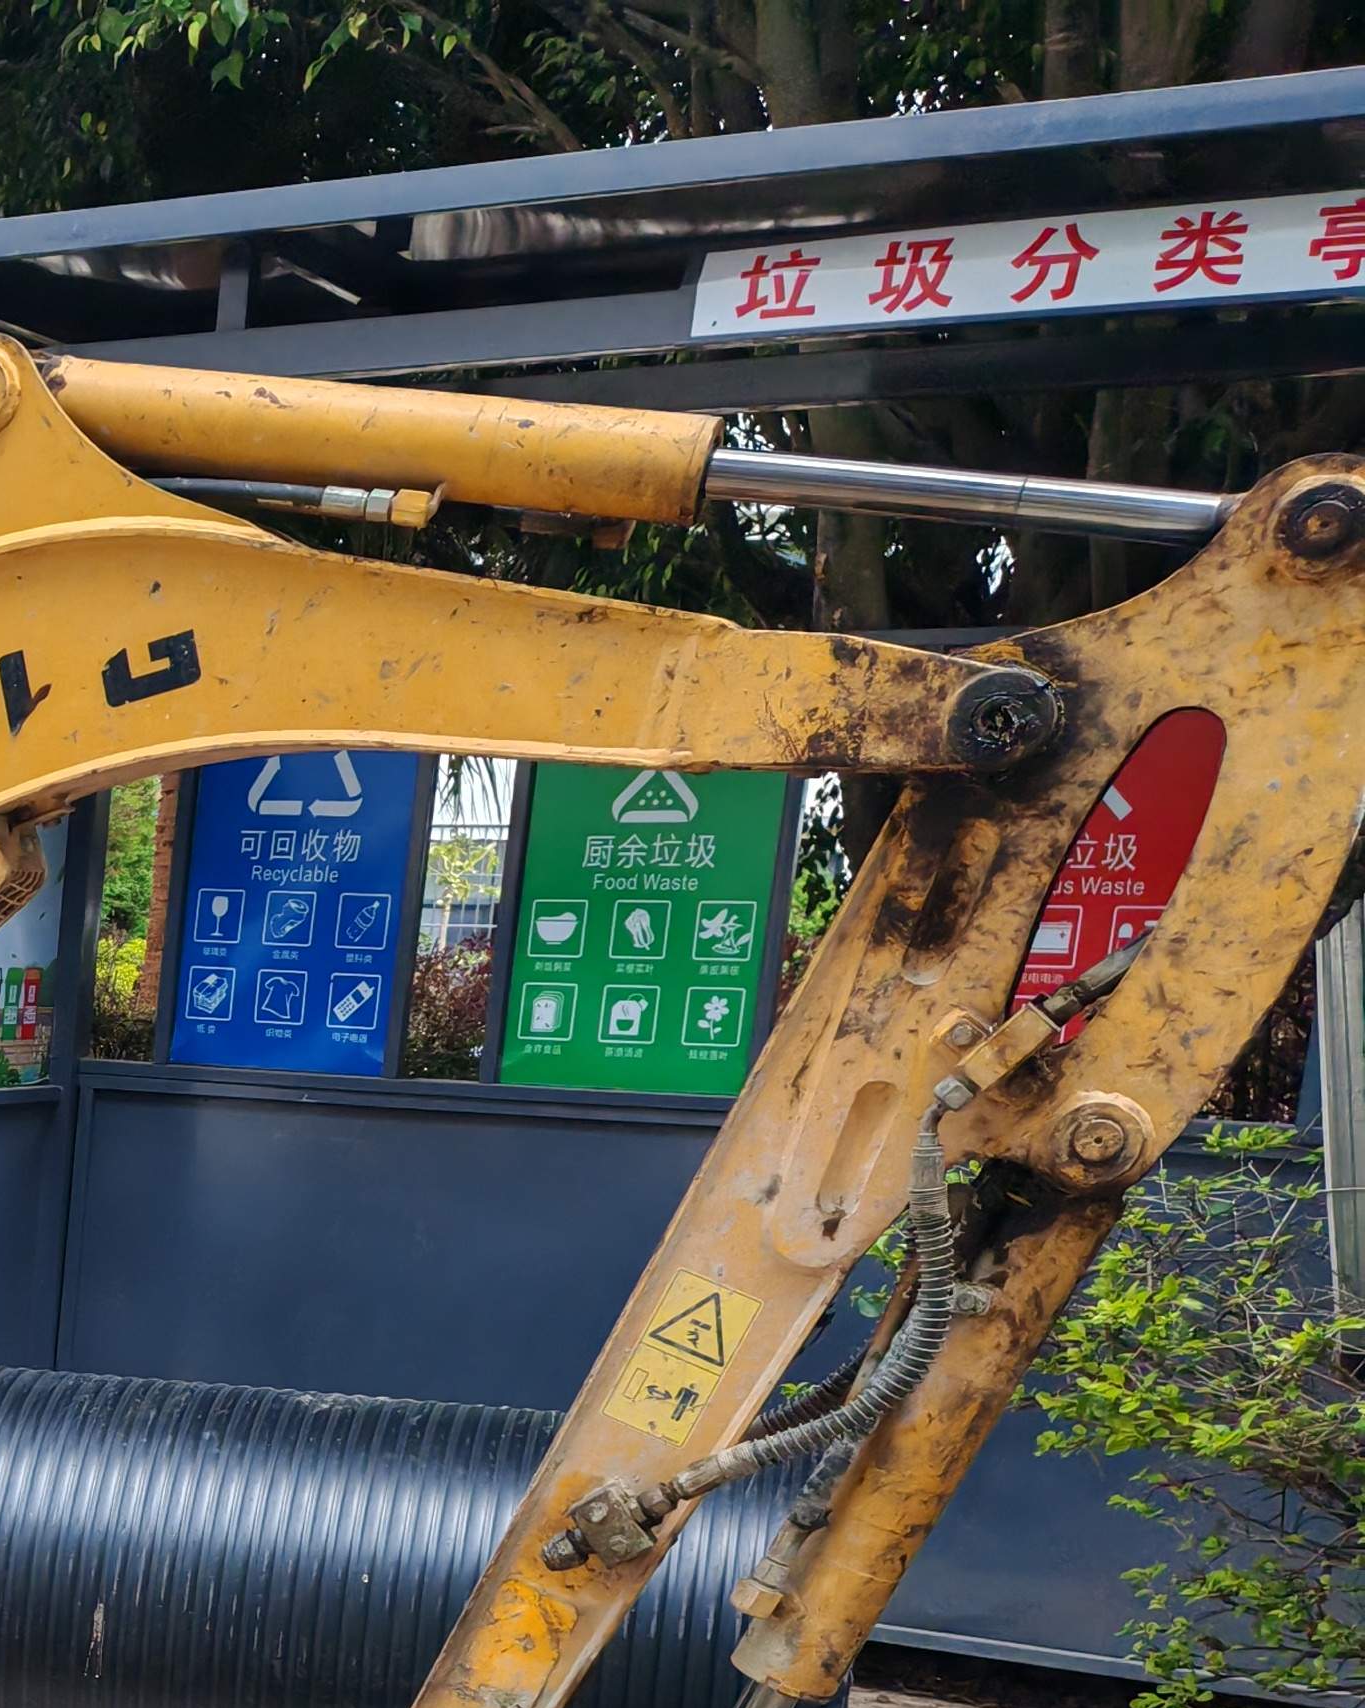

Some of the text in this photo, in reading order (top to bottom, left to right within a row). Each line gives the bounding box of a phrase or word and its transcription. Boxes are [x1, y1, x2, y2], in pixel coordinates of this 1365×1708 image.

[735, 197, 1365, 320] 垃圾分类亭
[240, 829, 362, 862] 可回收物
[582, 833, 716, 869] 厨余垃圾
[1066, 832, 1137, 871] 垃圾
[251, 865, 339, 887] Recyclable
[592, 873, 699, 891] Food Waste
[1081, 876, 1145, 895] Waste
